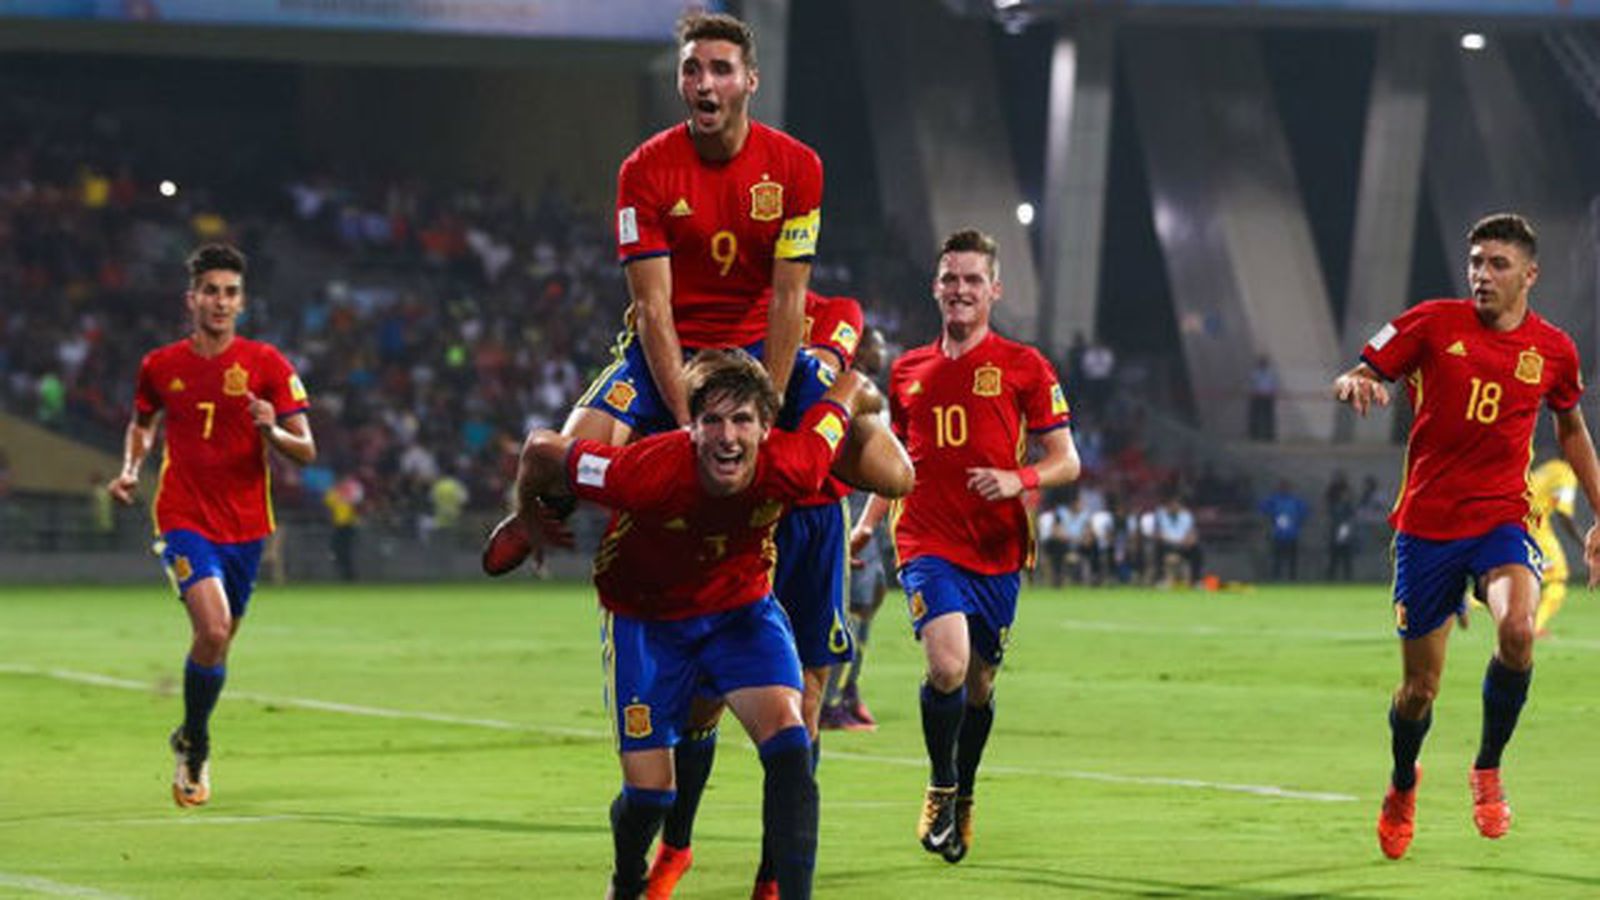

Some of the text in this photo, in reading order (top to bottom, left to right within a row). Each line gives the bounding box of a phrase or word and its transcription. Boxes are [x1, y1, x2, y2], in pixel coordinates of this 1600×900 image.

[711, 230, 737, 276] 9
[196, 402, 216, 439] 7
[1465, 377, 1502, 424] 18
[932, 404, 968, 448] 10
